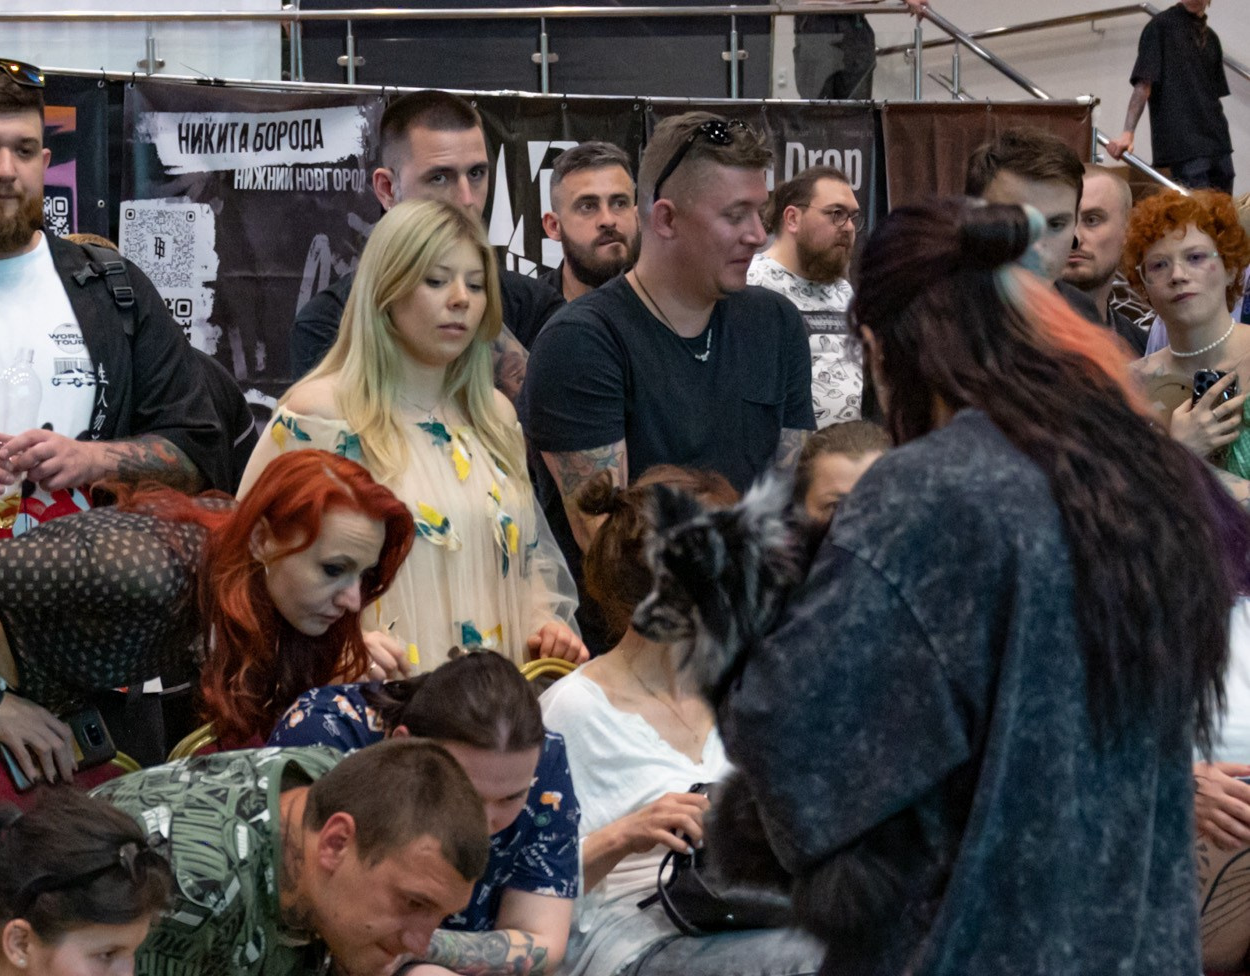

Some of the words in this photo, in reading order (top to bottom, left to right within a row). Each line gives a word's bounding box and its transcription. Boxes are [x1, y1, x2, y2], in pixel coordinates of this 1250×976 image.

[178, 122, 249, 154] НИКИТА
[253, 118, 324, 152] БОРОДА
[295, 167, 366, 193] НОВГОРОД
[784, 141, 863, 191] Drop
[92, 362, 109, 440] 生人勿
